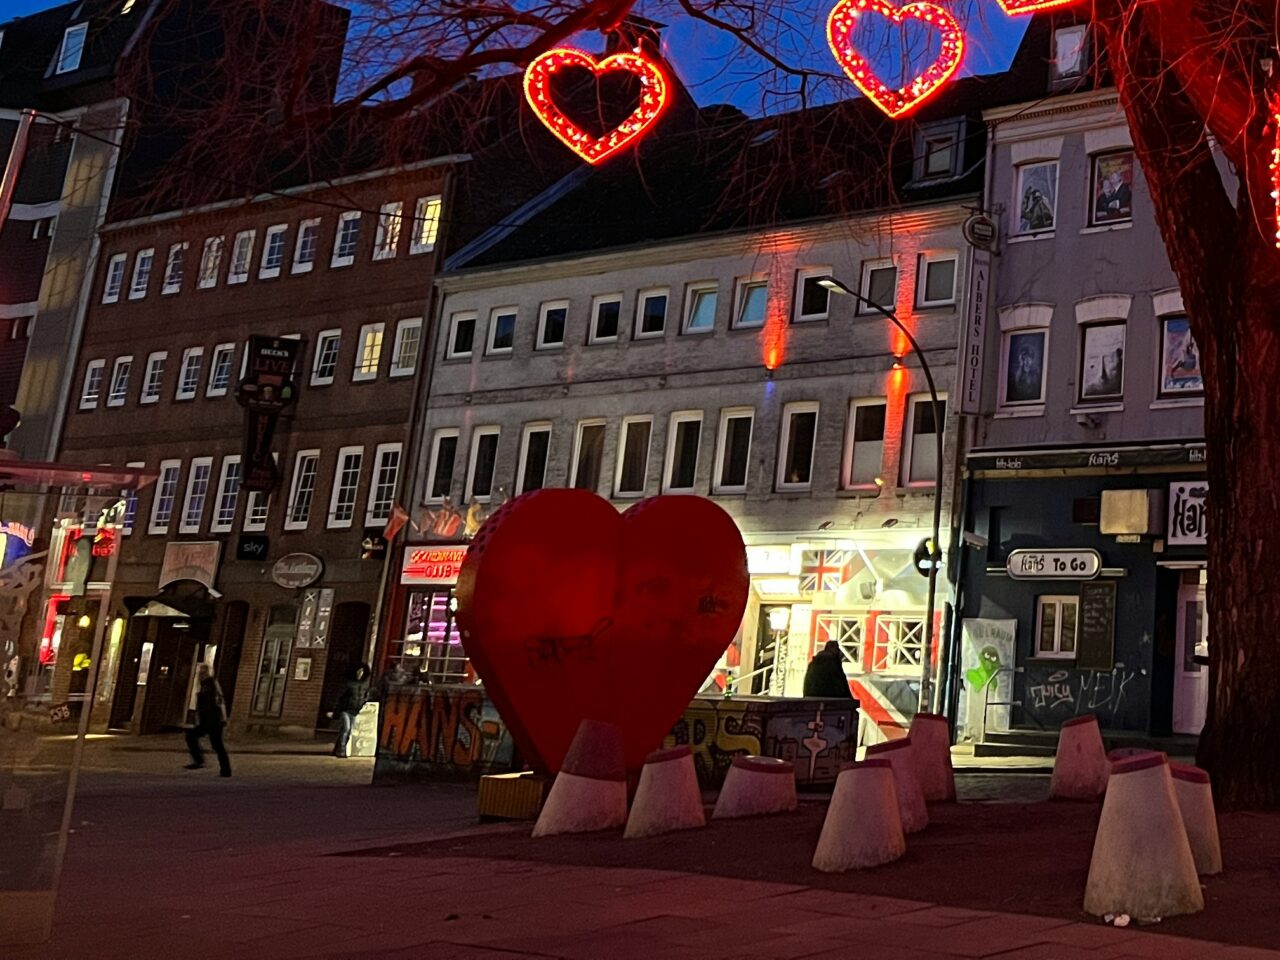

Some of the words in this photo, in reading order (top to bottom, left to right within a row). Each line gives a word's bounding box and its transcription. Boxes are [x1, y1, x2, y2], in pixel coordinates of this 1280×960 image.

[974, 270, 985, 338] ALBERS
[968, 344, 980, 402] HOTEL
[1171, 486, 1208, 538] Han
[243, 541, 264, 555] sky
[1020, 554, 1045, 573] Hans
[1053, 557, 1067, 571] To
[1070, 557, 1087, 571] Go
[424, 564, 453, 578] CLUB
